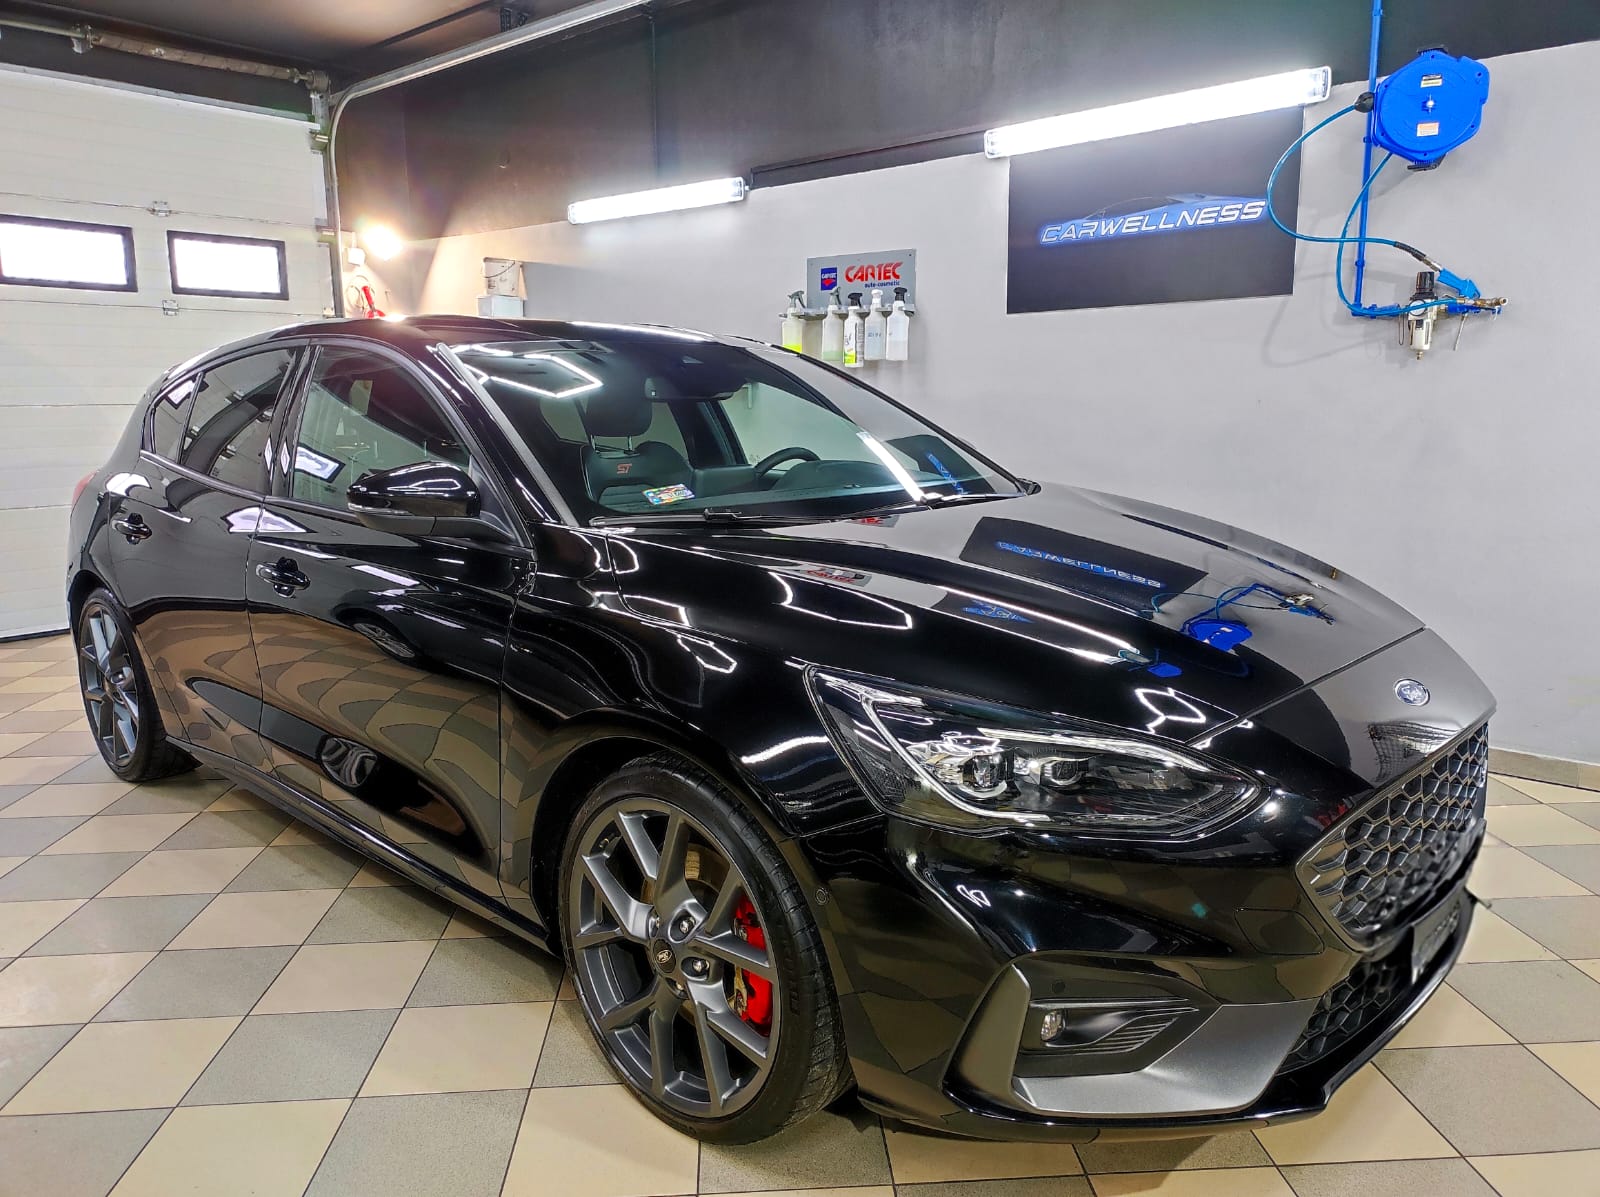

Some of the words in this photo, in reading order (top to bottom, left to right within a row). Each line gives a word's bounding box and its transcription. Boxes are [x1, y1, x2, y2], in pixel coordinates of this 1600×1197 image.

[1041, 200, 1267, 244] CARWELLNESS
[845, 262, 904, 283] CARTEC
[864, 280, 900, 288] auto-cosmetic
[617, 463, 633, 474] ST
